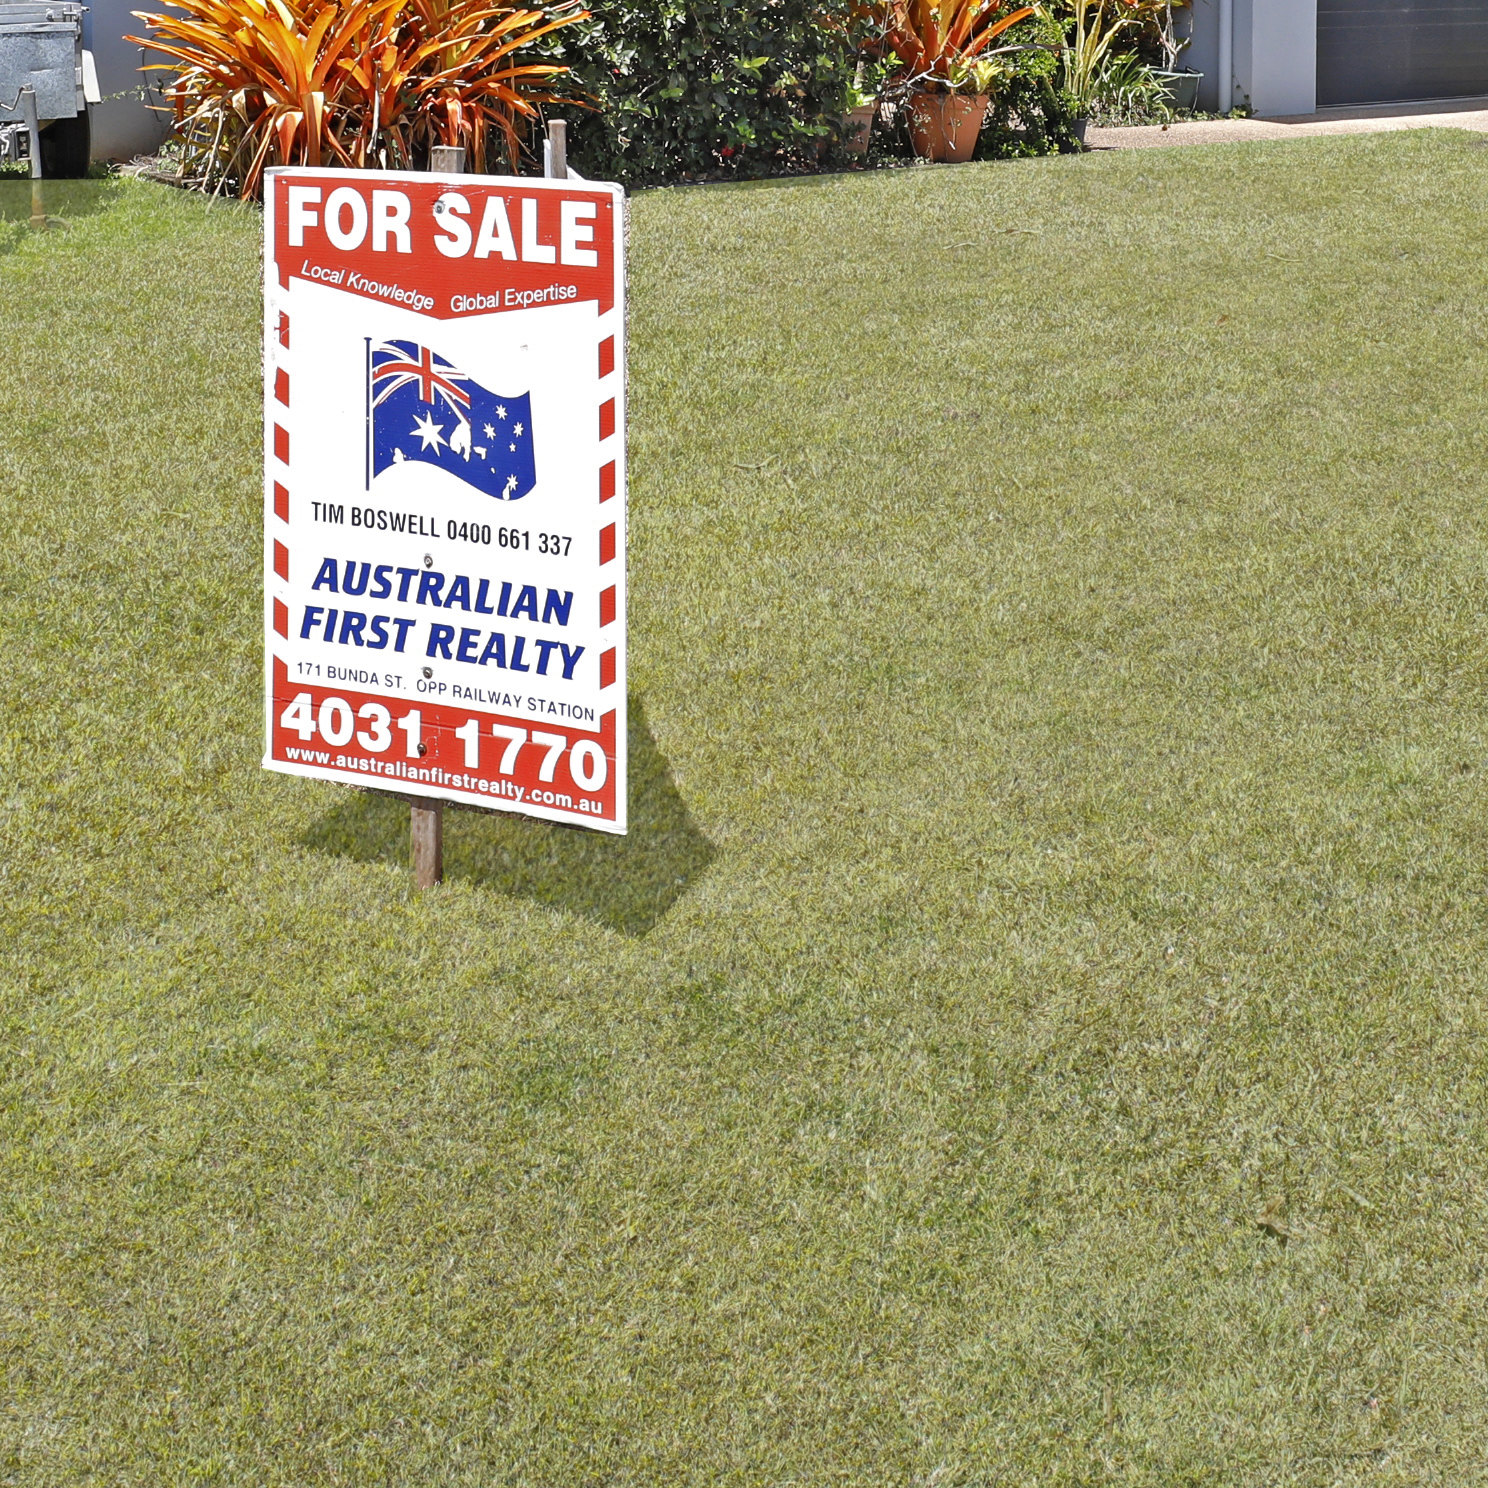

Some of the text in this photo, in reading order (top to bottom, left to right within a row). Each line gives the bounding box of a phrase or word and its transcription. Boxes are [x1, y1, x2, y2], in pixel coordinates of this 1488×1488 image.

[288, 185, 598, 267] FOR SALE
[301, 259, 434, 310] Local Knowledge
[450, 283, 577, 312] Global Expertise
[311, 501, 572, 556] TIM BOSWELL 0400 661 337
[311, 557, 573, 626] AUSTRALIAN
[300, 605, 585, 680] FIRST REALTY
[297, 662, 594, 722] 171 BUNDA ST. OPP RAILWAY STATION
[280, 692, 607, 792] 4031 1770
[285, 746, 602, 814] www.australianfirstrealty.com.au
